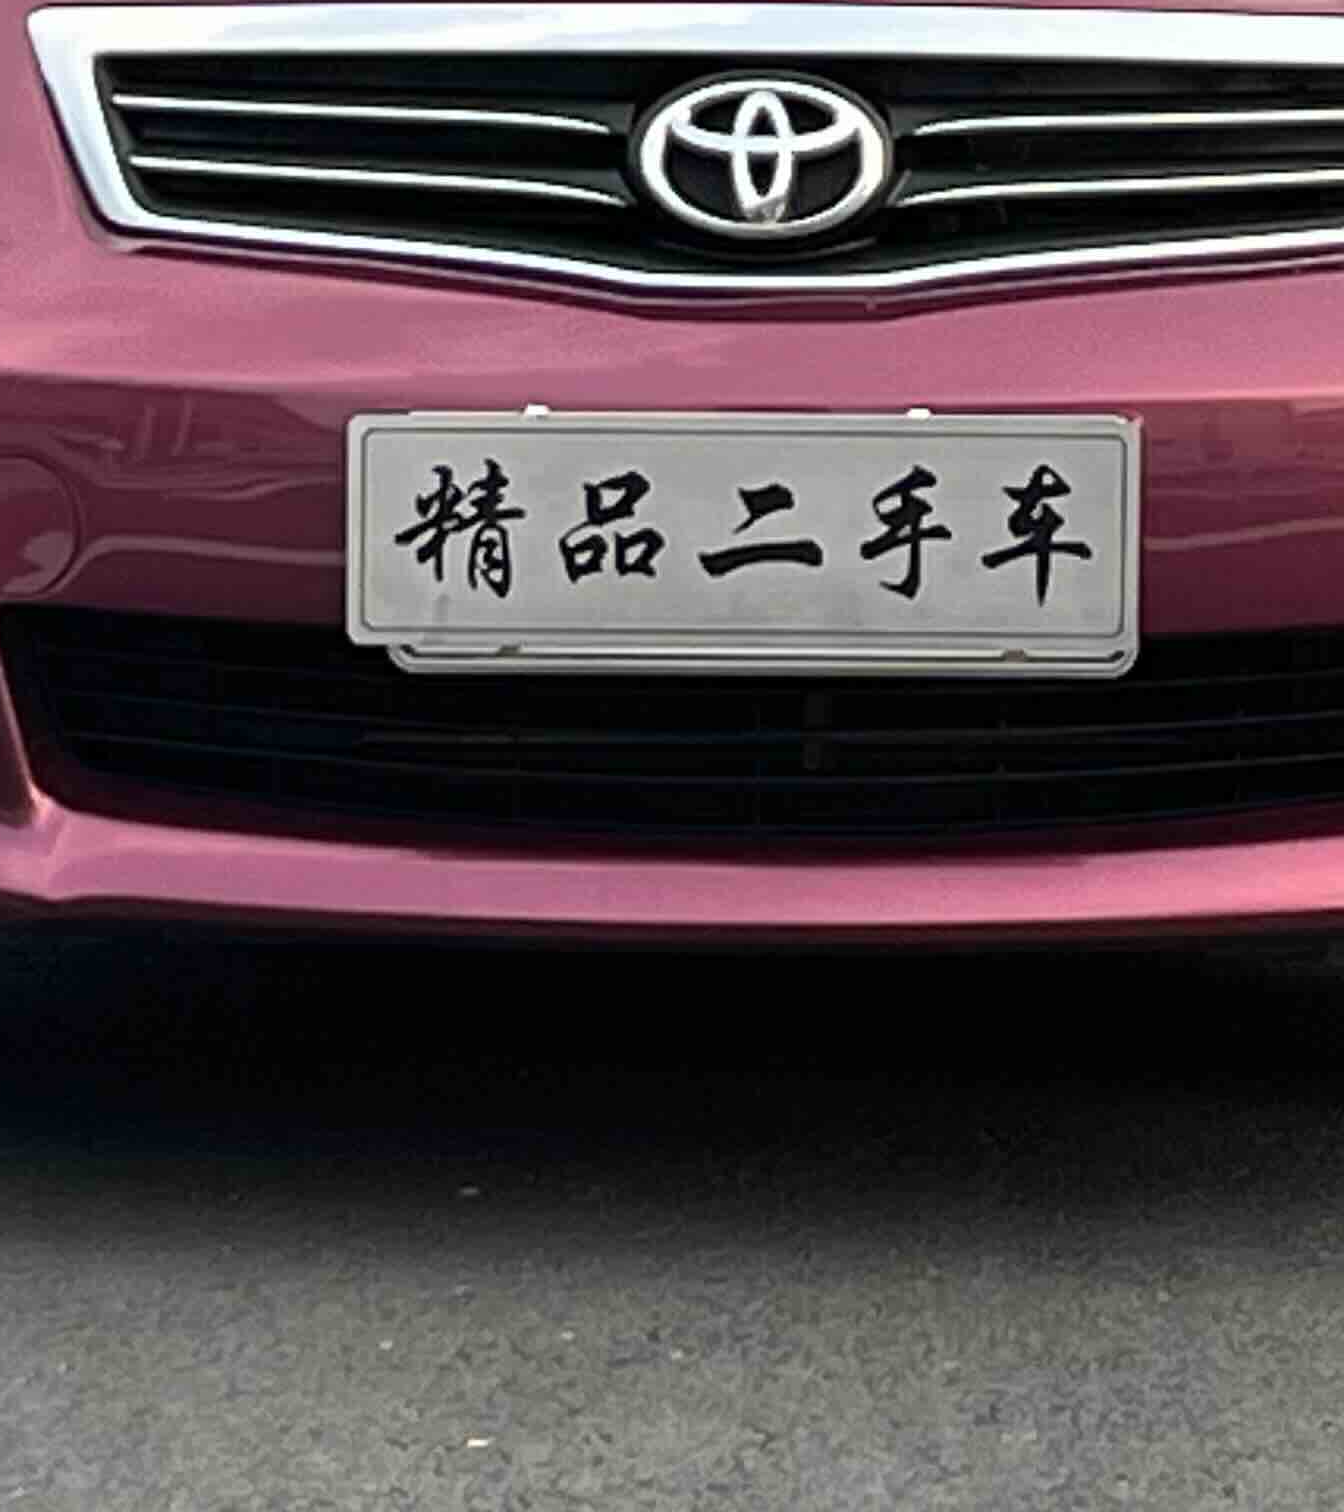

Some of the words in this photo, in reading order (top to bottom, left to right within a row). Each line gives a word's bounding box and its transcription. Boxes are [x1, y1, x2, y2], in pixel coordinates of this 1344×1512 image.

[393, 458, 1094, 606] 精品二手车
